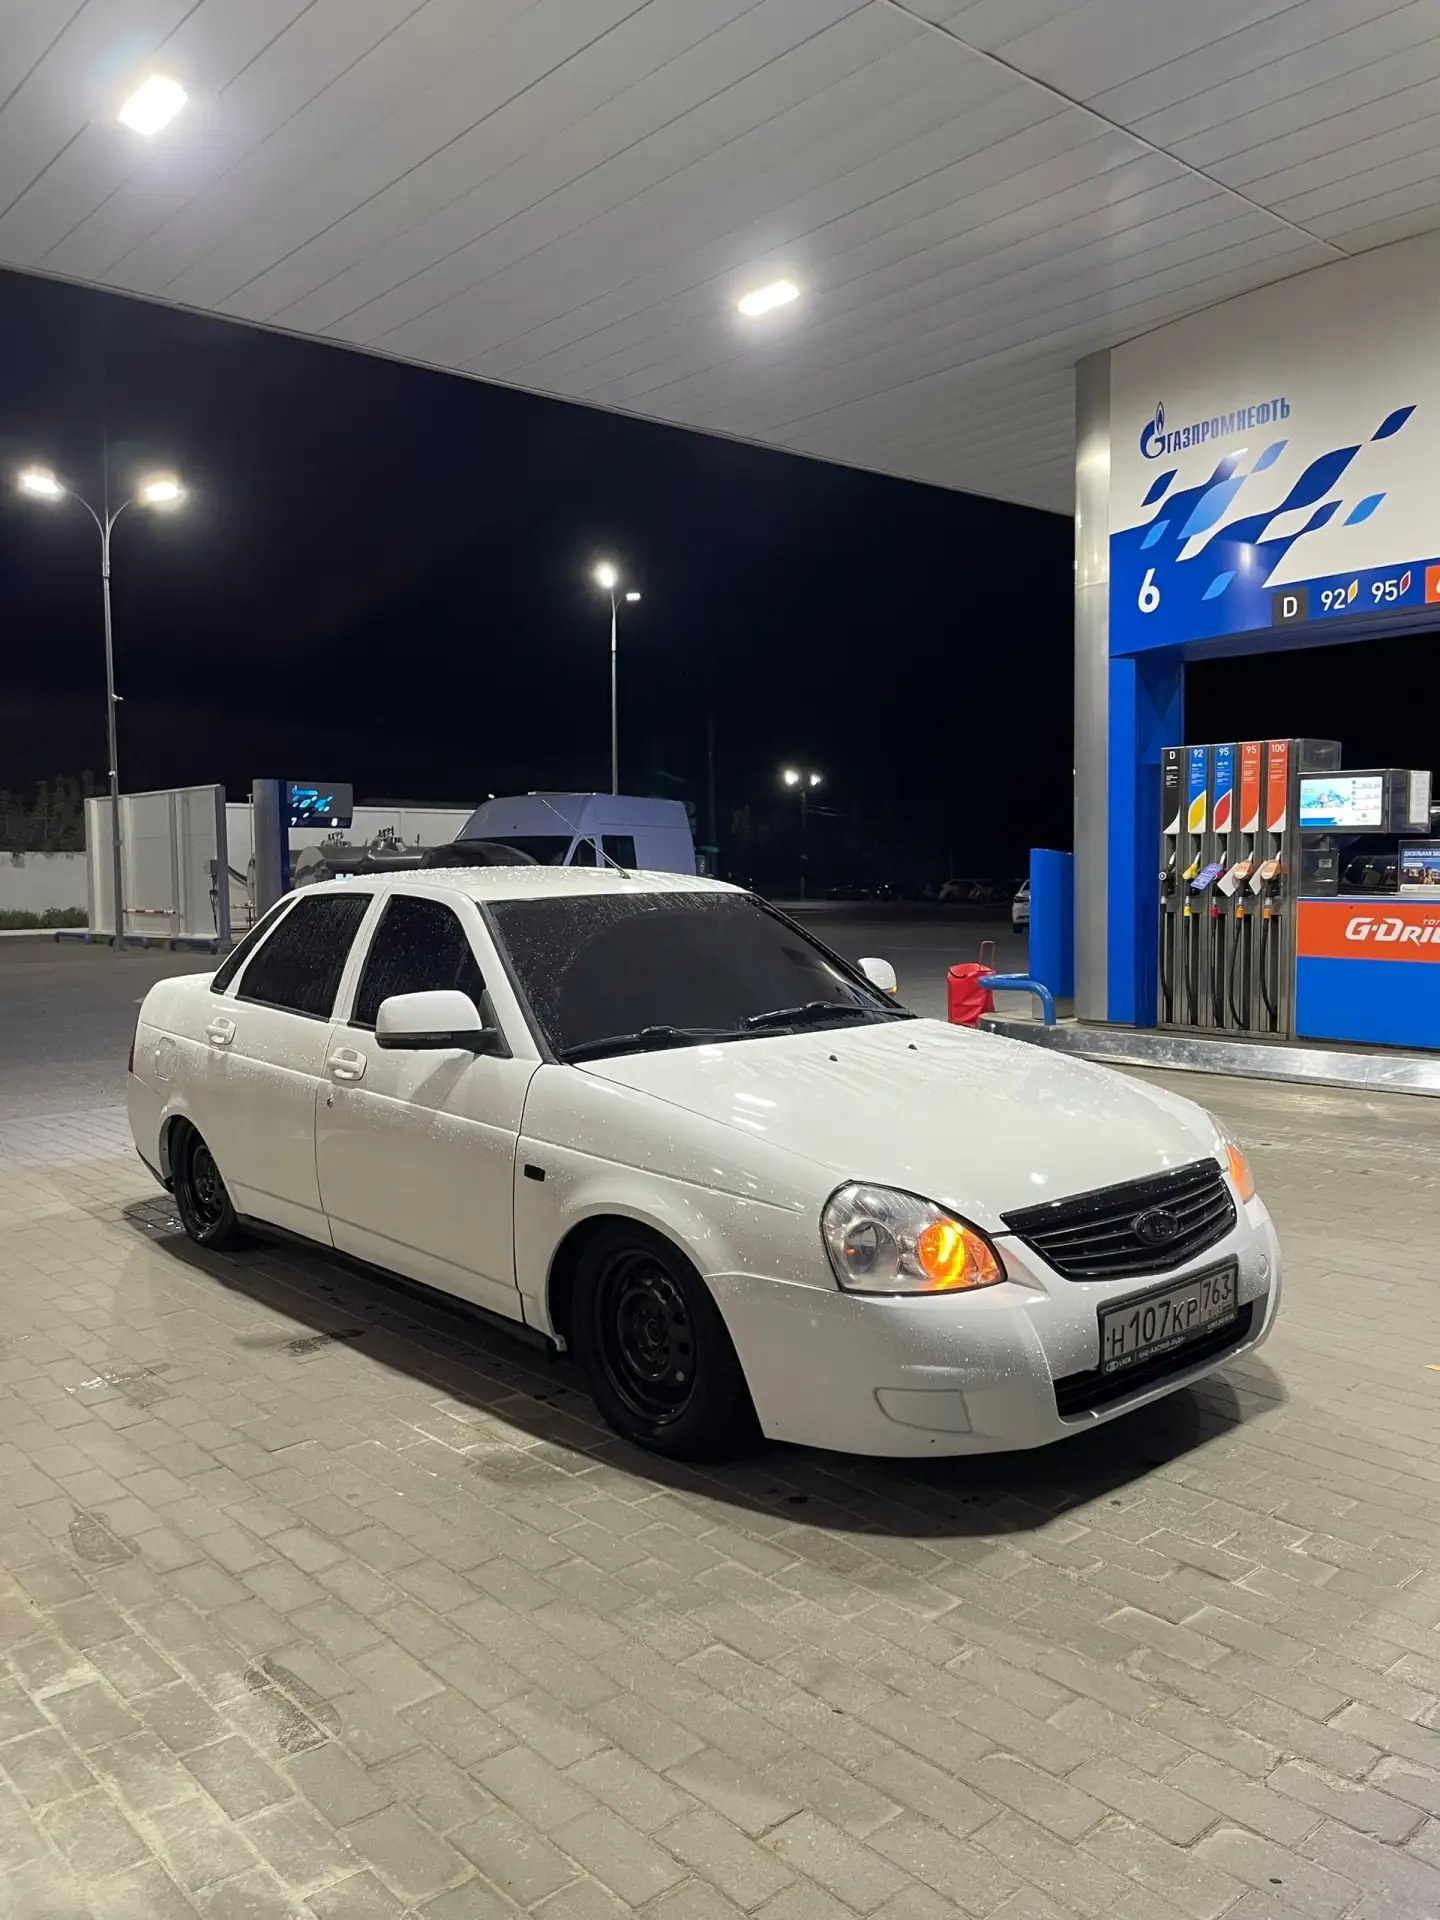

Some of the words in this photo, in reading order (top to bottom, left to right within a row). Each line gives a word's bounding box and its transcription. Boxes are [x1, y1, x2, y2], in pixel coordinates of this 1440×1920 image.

[1165, 398, 1291, 454] ГАЗПРОМНЕФТЬ
[1137, 568, 1160, 613] 6
[1283, 596, 1297, 617] D
[1321, 588, 1346, 611] 92
[1371, 580, 1398, 603] 95
[1218, 747, 1229, 756] 95
[1246, 745, 1257, 754] 95
[1271, 743, 1285, 753] 100
[1169, 751, 1176, 760] D
[1193, 749, 1204, 758] 92
[1202, 1274, 1230, 1310] 763
